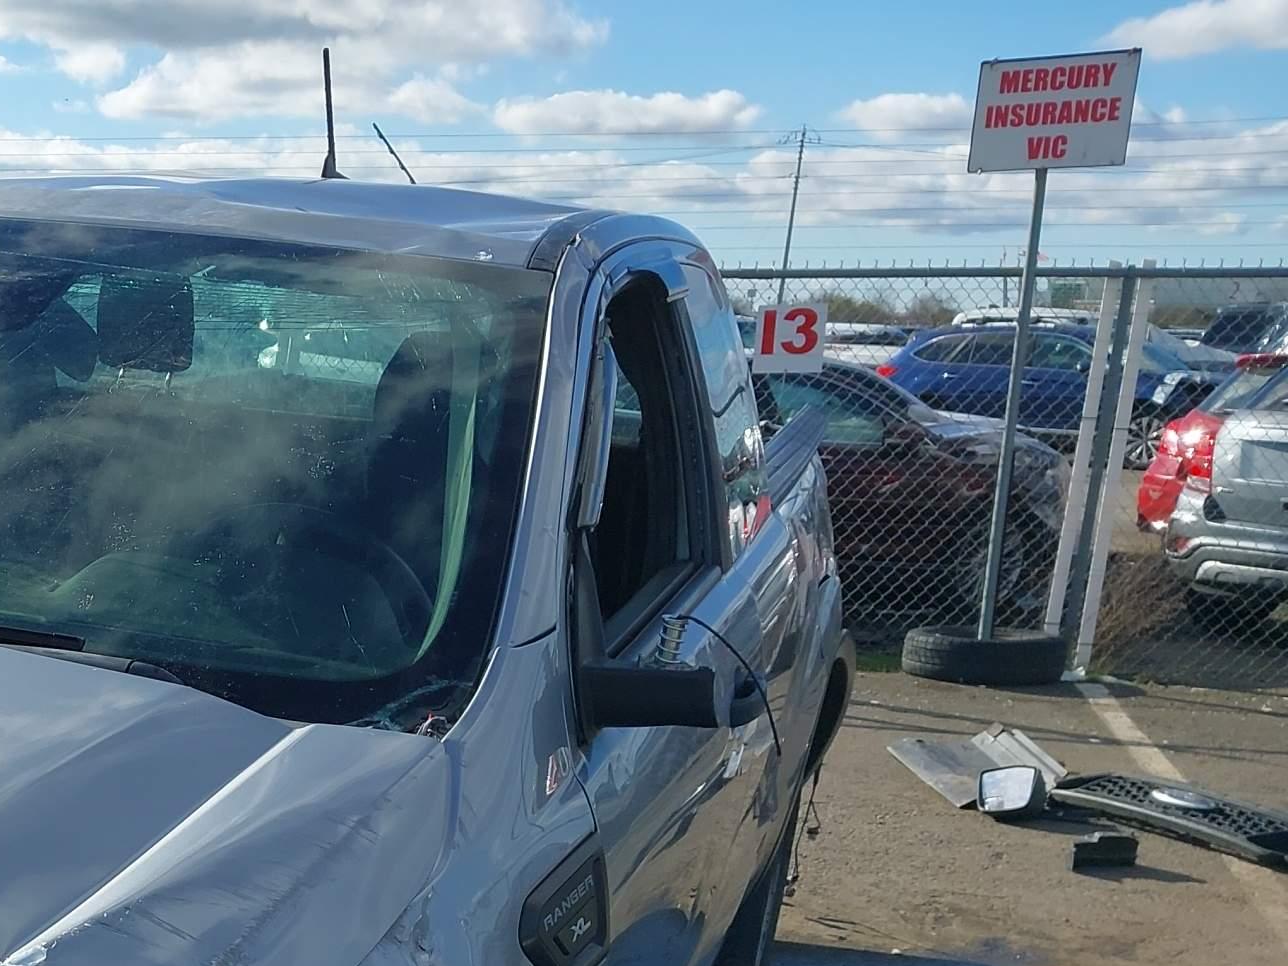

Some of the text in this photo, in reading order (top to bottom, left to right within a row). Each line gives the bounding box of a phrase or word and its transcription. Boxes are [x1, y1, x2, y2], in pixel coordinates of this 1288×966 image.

[999, 62, 1117, 94] MERCURY
[985, 97, 1122, 129] INSURANCE
[1027, 135, 1068, 160] VIC
[760, 308, 818, 355] 13
[543, 874, 594, 932] RANGER
[569, 917, 592, 942] XL
